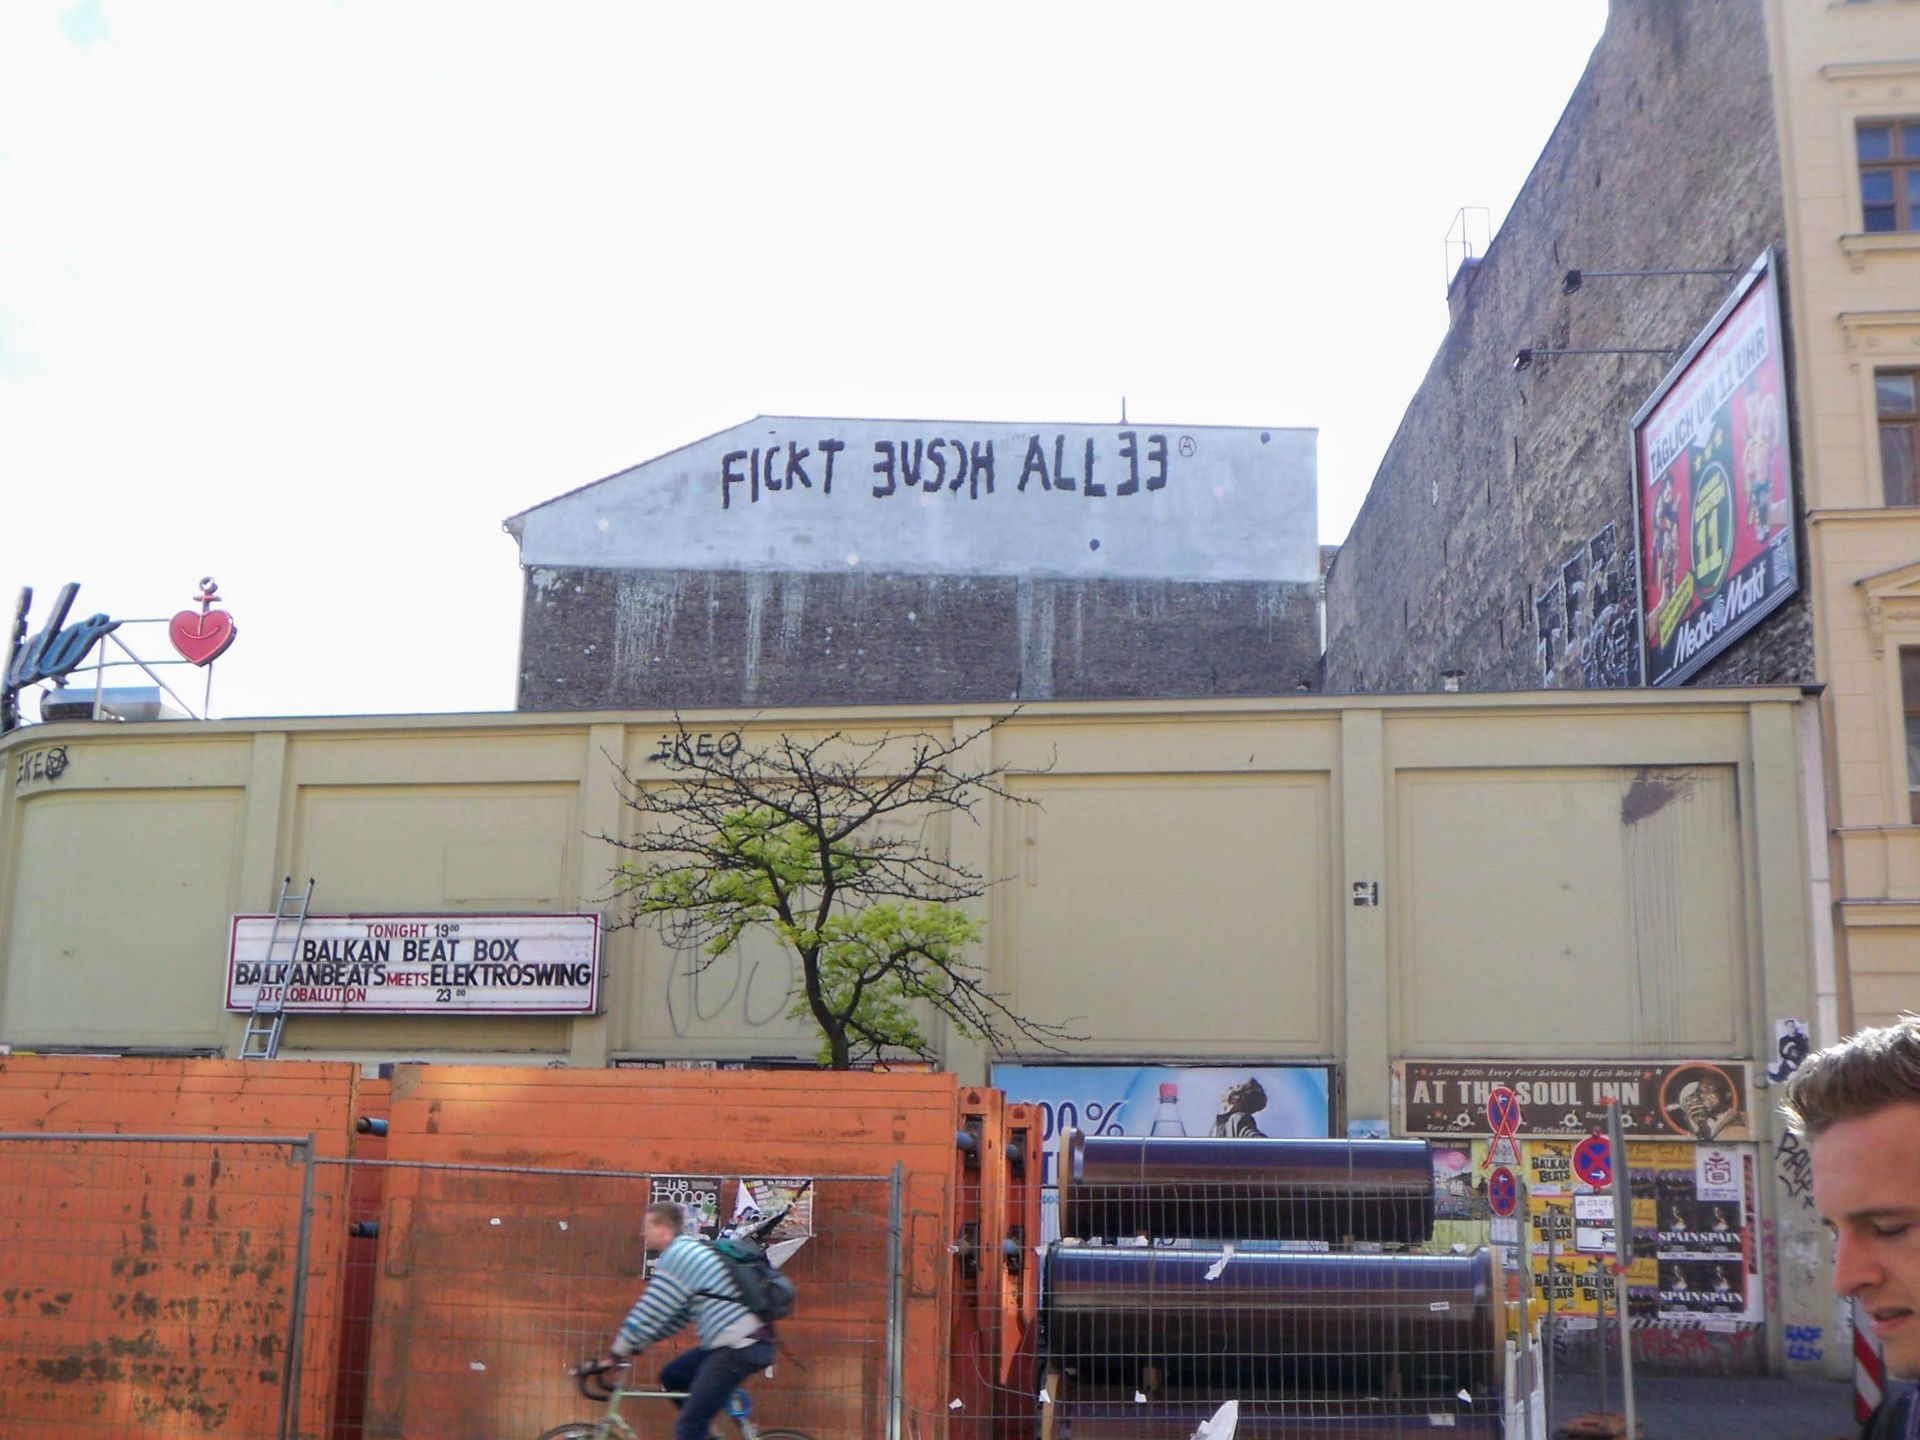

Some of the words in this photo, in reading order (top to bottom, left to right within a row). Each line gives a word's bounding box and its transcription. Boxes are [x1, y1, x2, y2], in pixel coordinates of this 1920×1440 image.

[1696, 381, 1716, 424] UM
[1736, 326, 1767, 378] UHR
[722, 438, 845, 509] FICKT
[1017, 430, 1169, 498] ALLEE
[1674, 608, 1713, 669] Media
[1722, 560, 1767, 626] Markt
[366, 924, 428, 938] TONIGHT
[303, 939, 390, 962] BALKAN
[402, 939, 460, 962] BEAT
[473, 938, 519, 962] BOX
[386, 972, 429, 986] MEETS
[430, 963, 592, 986] ELEKTROSWING
[1488, 1069, 1513, 1078] Every
[1515, 1069, 1536, 1077] First
[1538, 1069, 1577, 1078] Saturday
[1413, 1081, 1447, 1104] AT
[1516, 1081, 1582, 1105] SOUL
[1592, 1081, 1640, 1105] INN
[1531, 1157, 1570, 1170] BALKAN
[1539, 1170, 1571, 1183] BEATS
[1658, 1231, 1700, 1242] SPAIN
[1700, 1231, 1741, 1243] SPAIN
[1660, 1291, 1701, 1302] SPAIN
[1702, 1292, 1743, 1303] SPAIN
